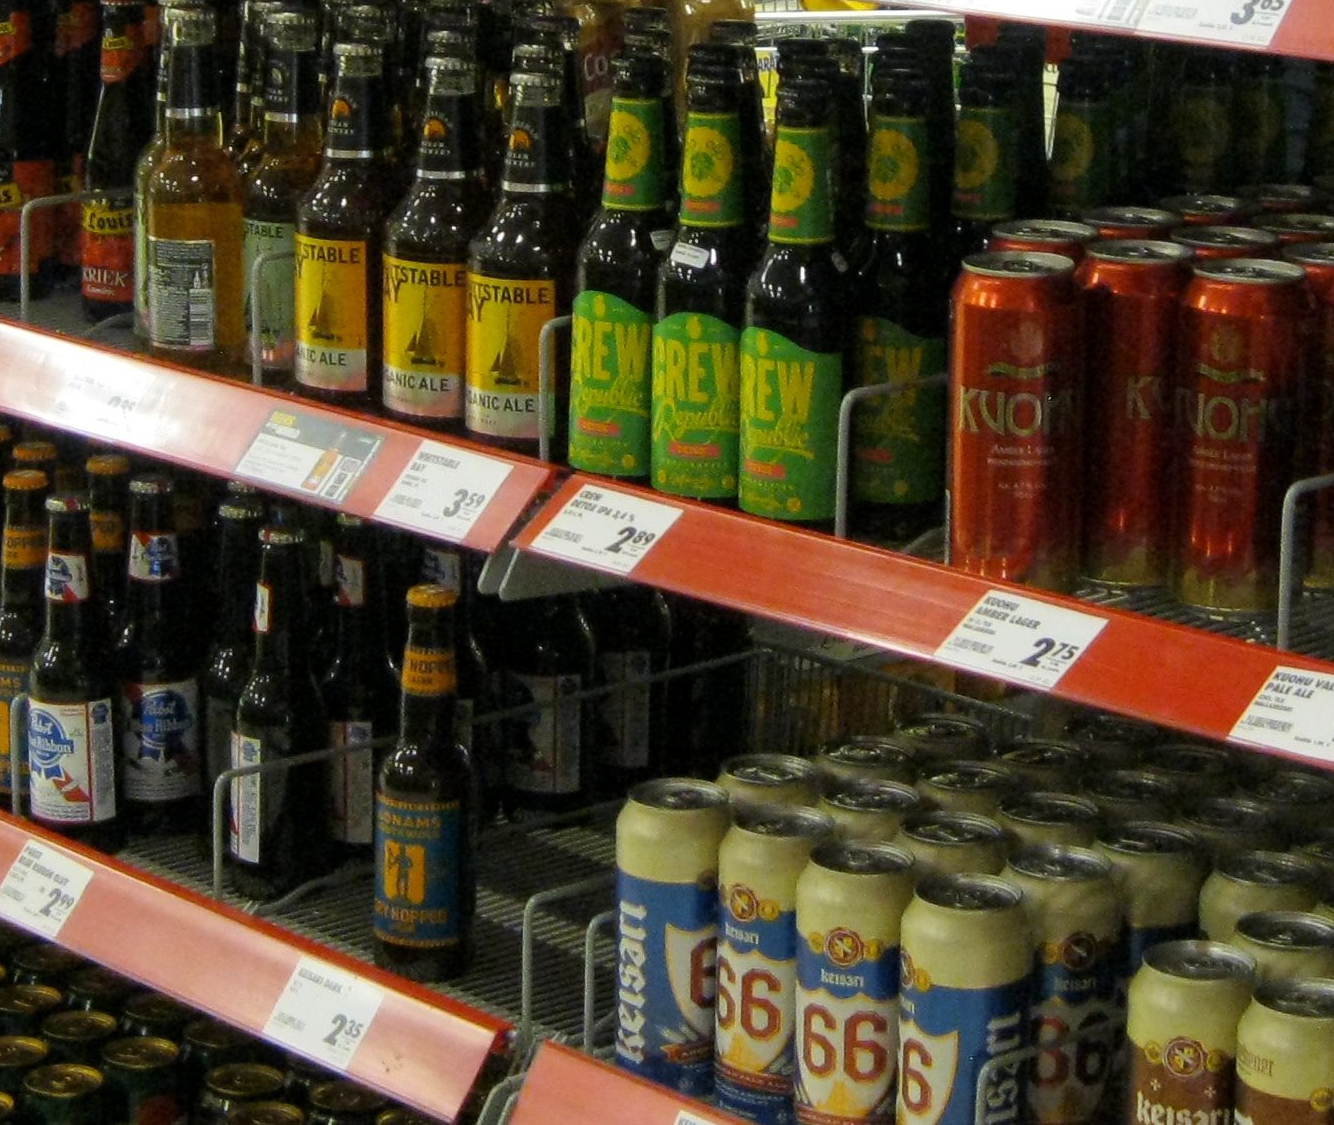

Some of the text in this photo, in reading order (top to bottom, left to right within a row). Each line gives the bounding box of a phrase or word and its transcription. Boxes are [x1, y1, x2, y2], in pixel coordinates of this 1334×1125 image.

[503, 394, 535, 413] ALE
[983, 595, 1021, 609] KUOHU
[975, 606, 1011, 623] AMBER
[1011, 615, 1042, 630] LAGER
[1273, 671, 1314, 689] KUOHU
[1266, 681, 1315, 701] PALE ALE
[803, 1002, 889, 1090] 66
